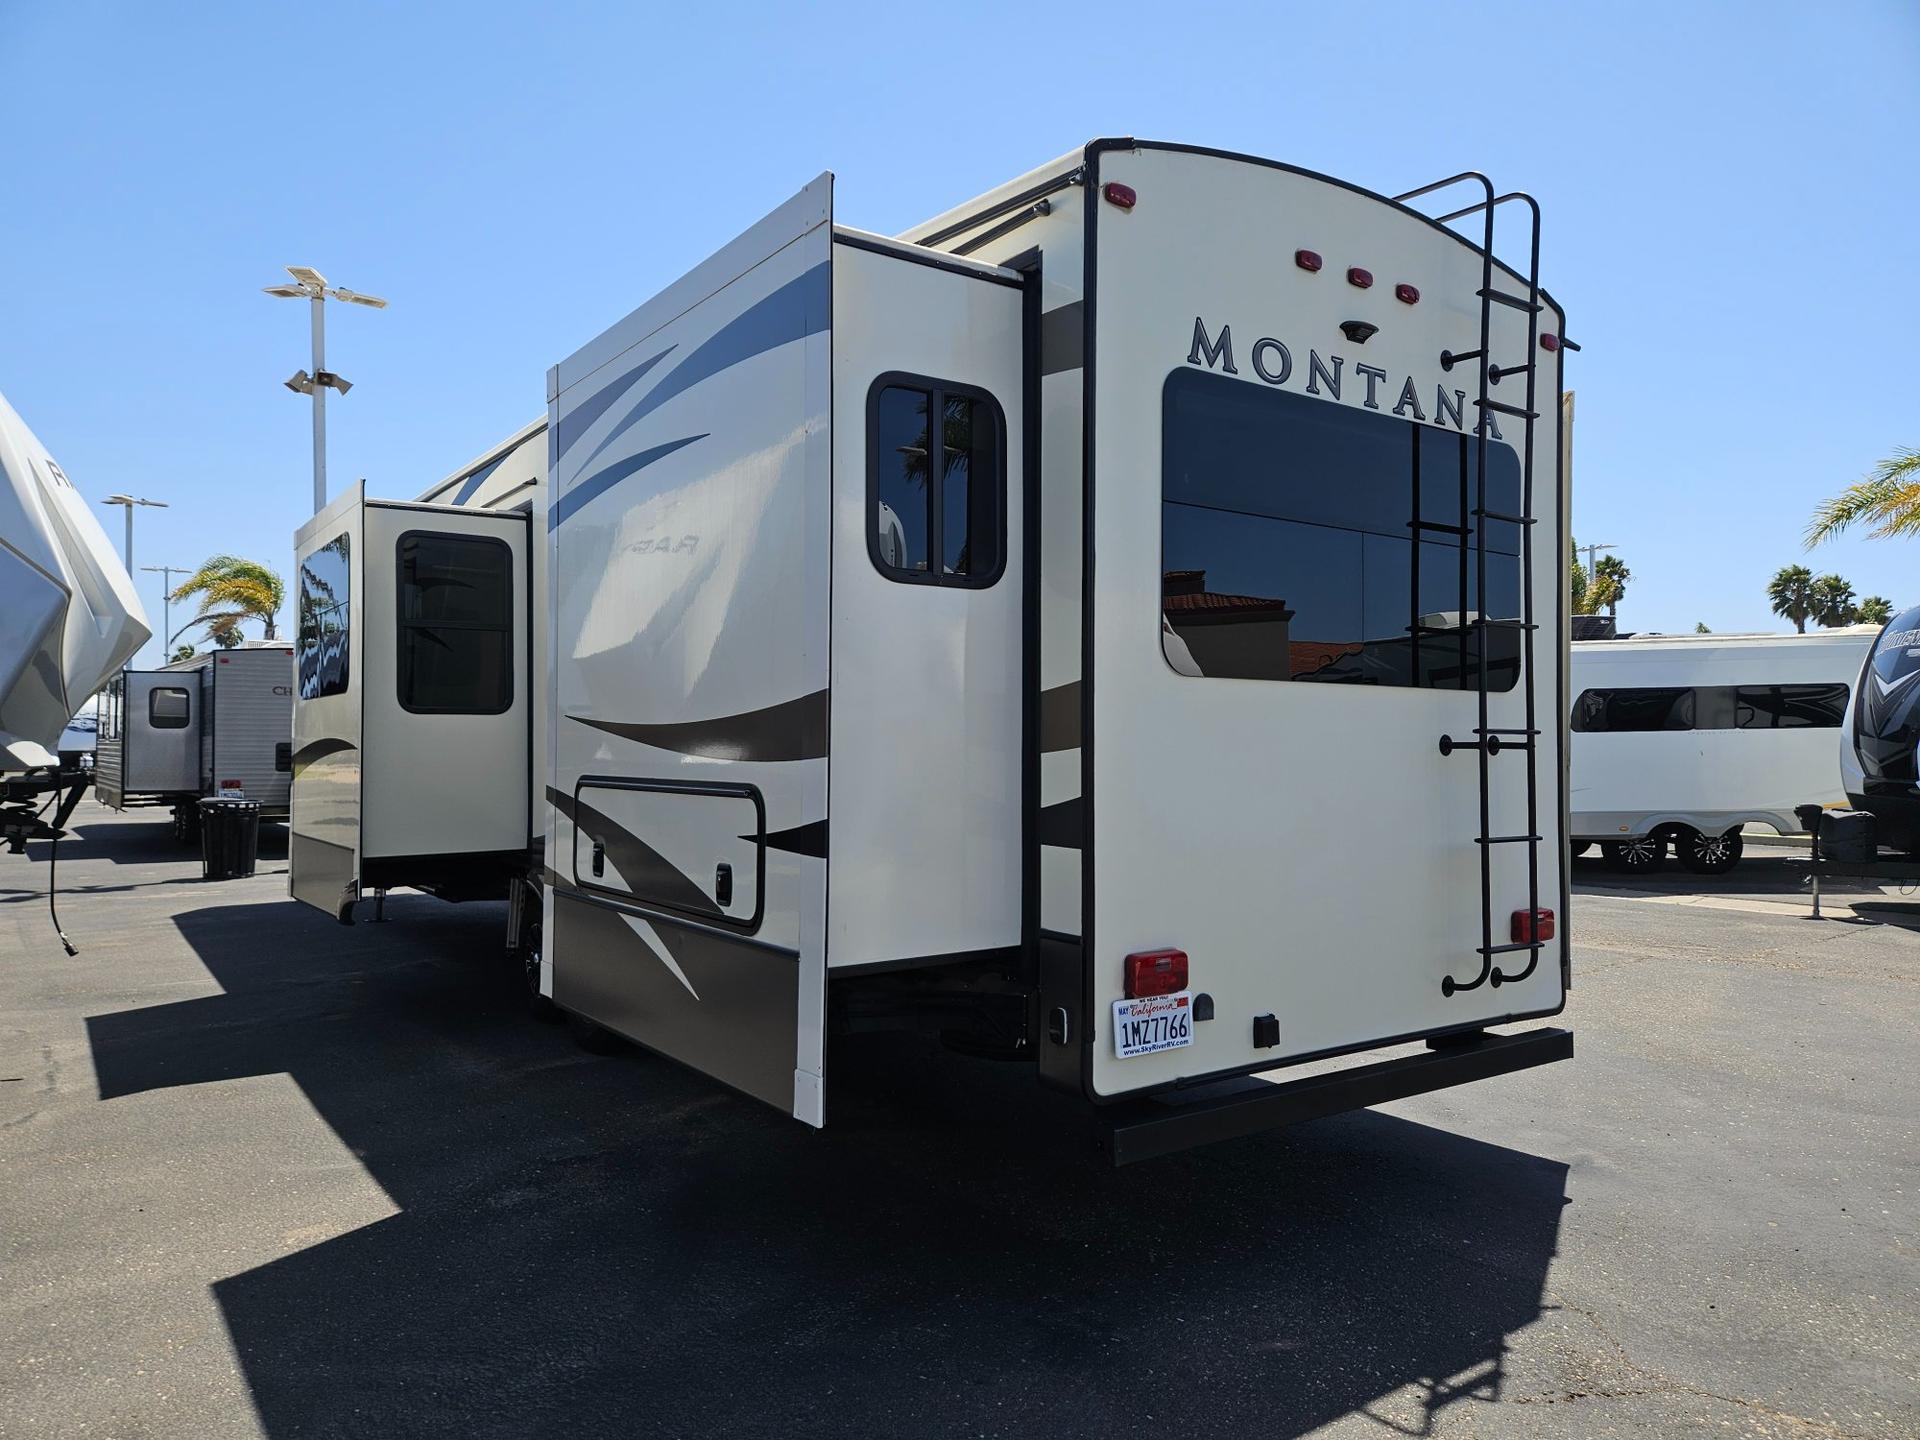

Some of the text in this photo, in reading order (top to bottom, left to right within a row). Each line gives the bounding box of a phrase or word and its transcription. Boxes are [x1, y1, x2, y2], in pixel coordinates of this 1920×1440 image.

[1187, 315, 1503, 440] MONTANA
[1118, 1001, 1177, 1018] MAY California
[1122, 1013, 1187, 1048] 1MZ7766
[1124, 1040, 1189, 1056] www.SkyRiverRV.com
